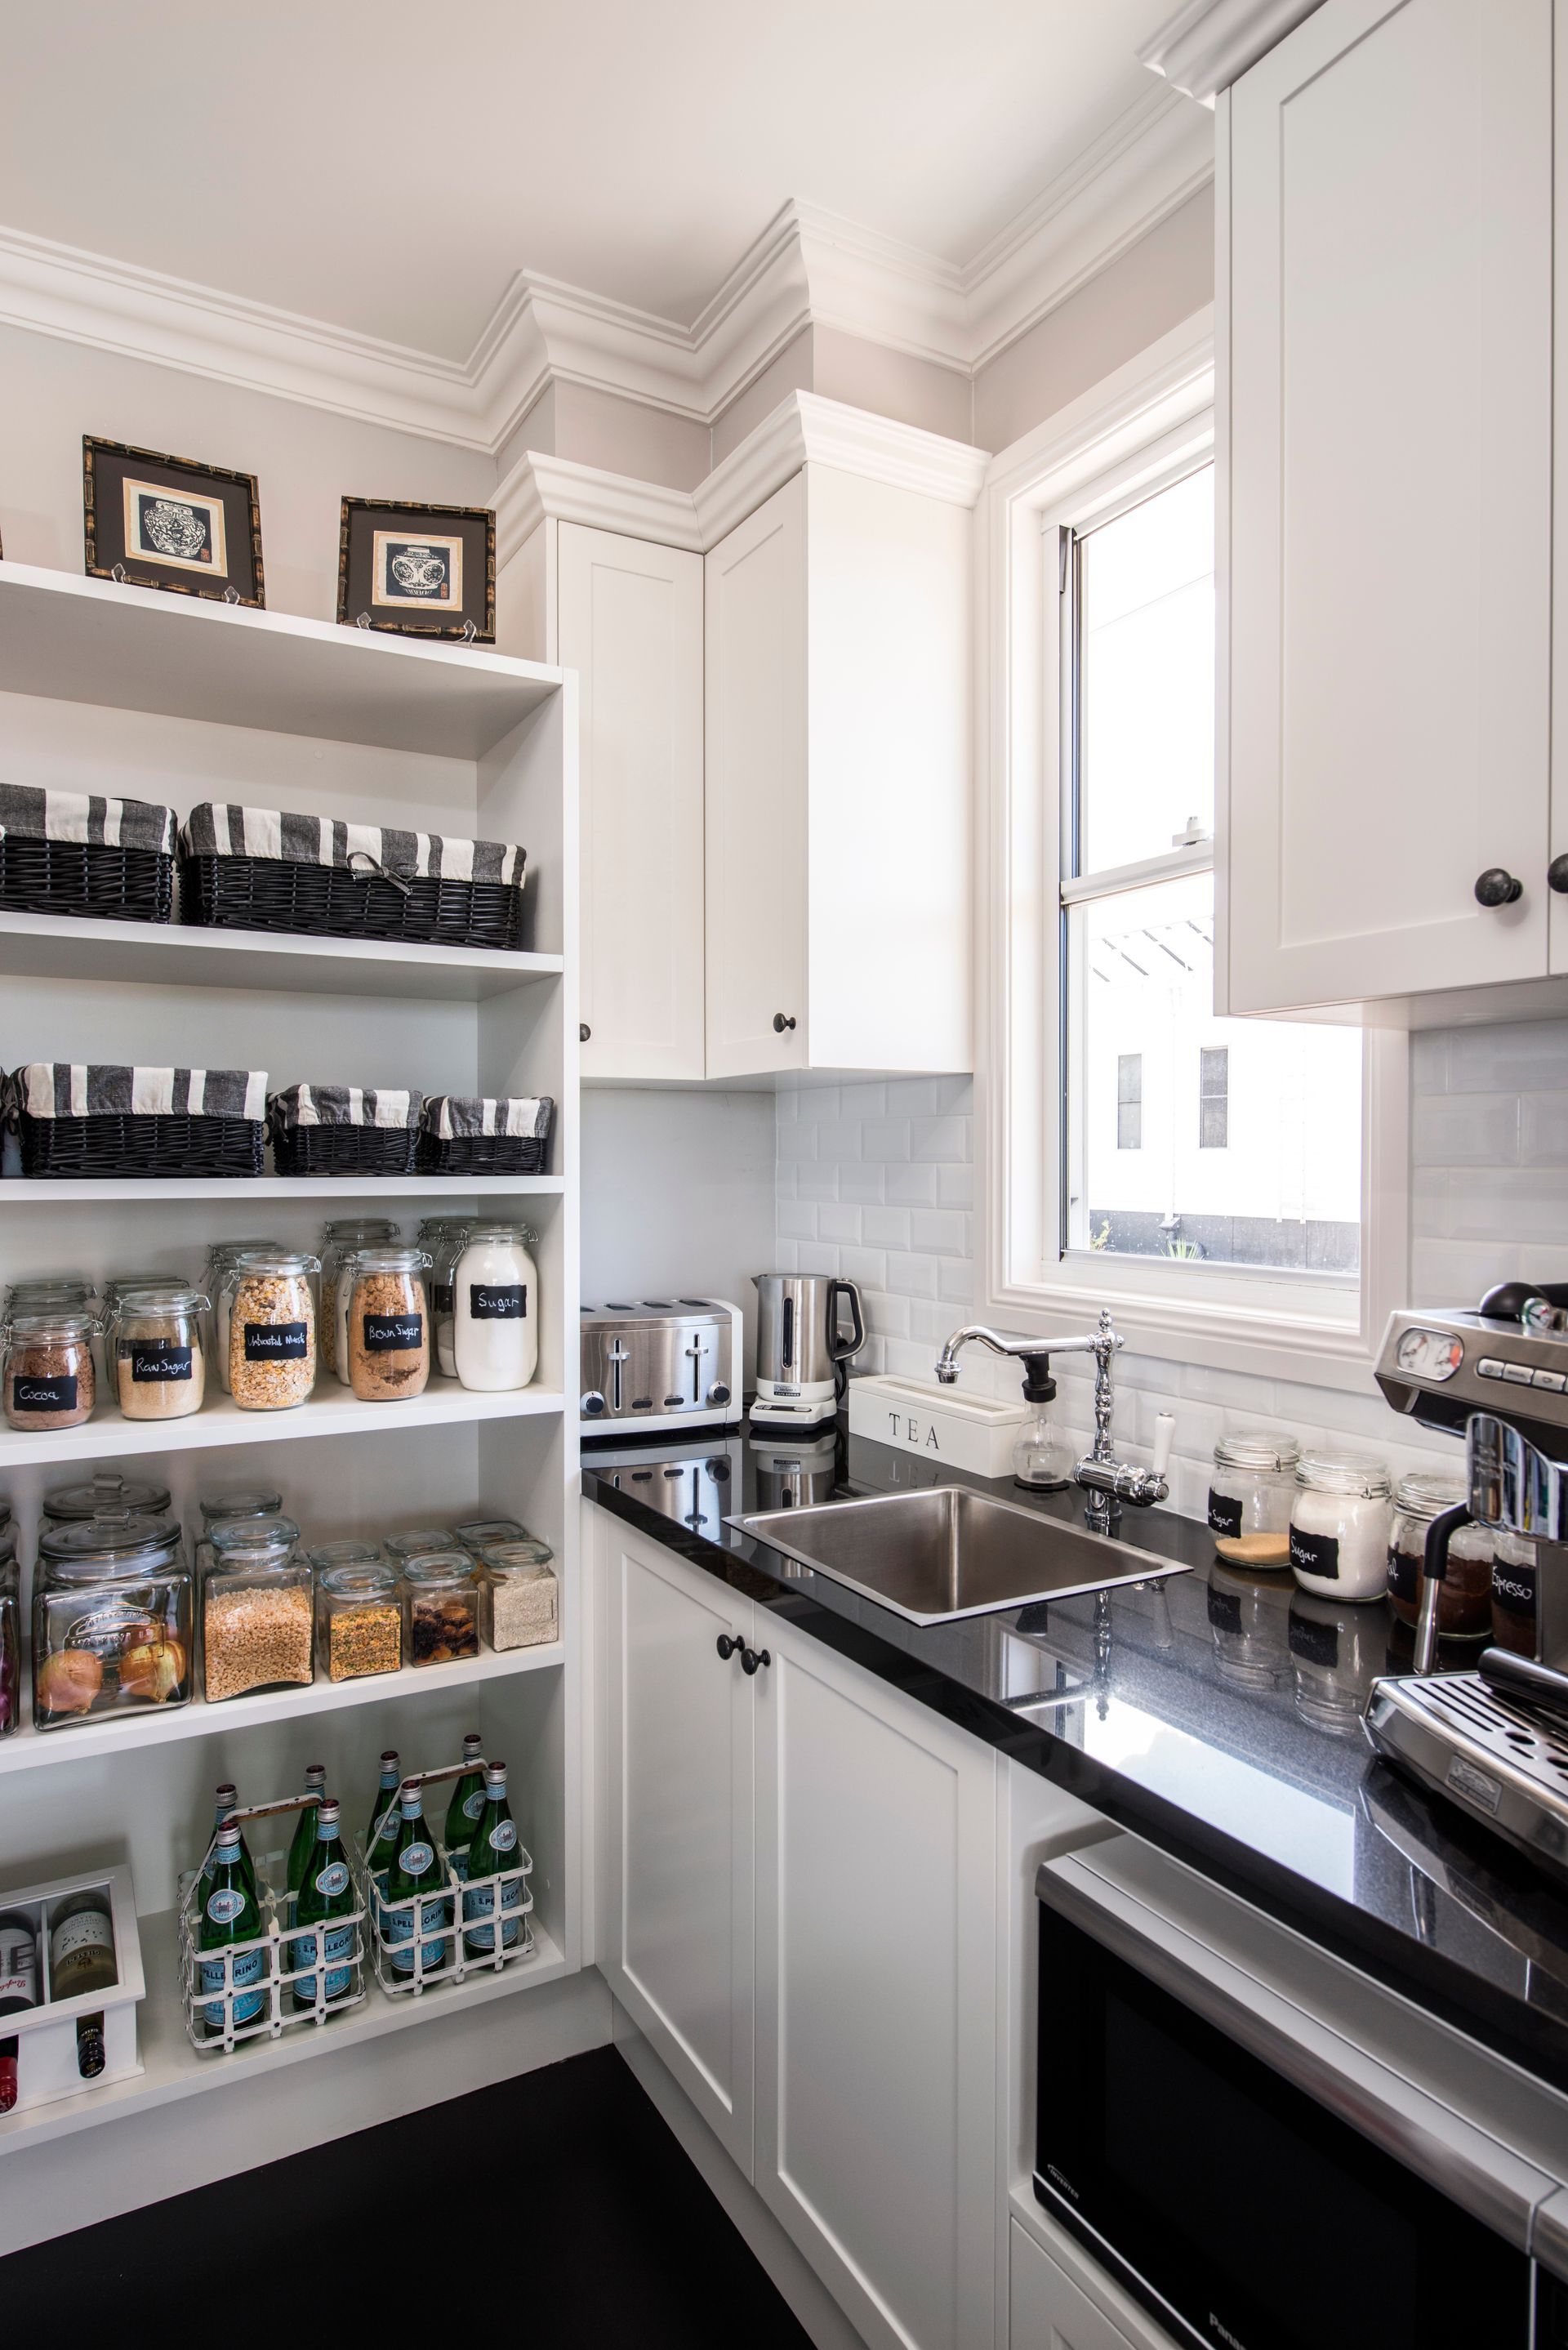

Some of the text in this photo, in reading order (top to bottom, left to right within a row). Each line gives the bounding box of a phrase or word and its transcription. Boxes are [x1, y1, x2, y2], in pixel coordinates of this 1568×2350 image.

[478, 1292, 519, 1313] Sugar
[369, 1323, 420, 1340] Brown Sugar
[136, 1357, 191, 1376] Raw Sugar
[20, 1385, 60, 1401] Cocoa
[889, 1412, 940, 1451] TEA
[1212, 1509, 1234, 1527] Sugar
[1290, 1535, 1318, 1563] Sugar
